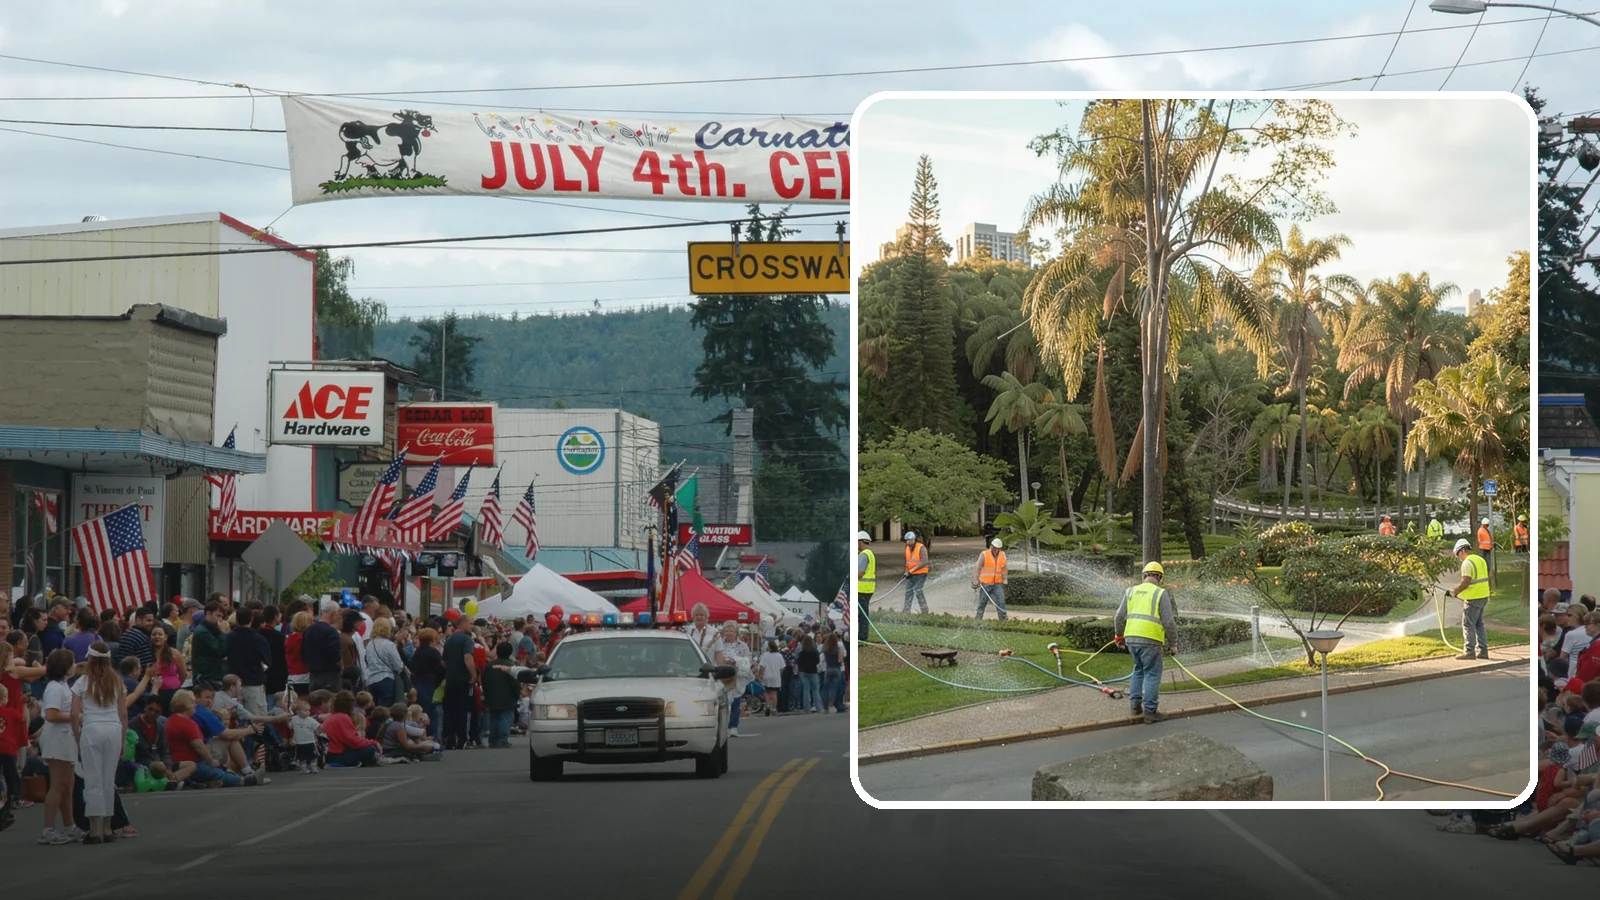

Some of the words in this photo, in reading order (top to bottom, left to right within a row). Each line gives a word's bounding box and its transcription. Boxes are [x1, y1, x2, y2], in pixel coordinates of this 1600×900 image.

[695, 121, 850, 149] Carnat
[481, 141, 604, 192] JULY
[632, 150, 746, 198] 4th.
[697, 254, 850, 280] CROSSWA
[282, 380, 373, 420] ACE
[406, 409, 452, 422] CEDAR
[284, 421, 371, 436] Hardware
[353, 467, 385, 481] Simpl
[84, 485, 93, 494] St.
[95, 485, 124, 495] Vincent
[126, 486, 136, 495] de
[138, 486, 155, 495] Paul
[688, 526, 742, 535] CRNATION
[699, 535, 730, 543] GLASS
